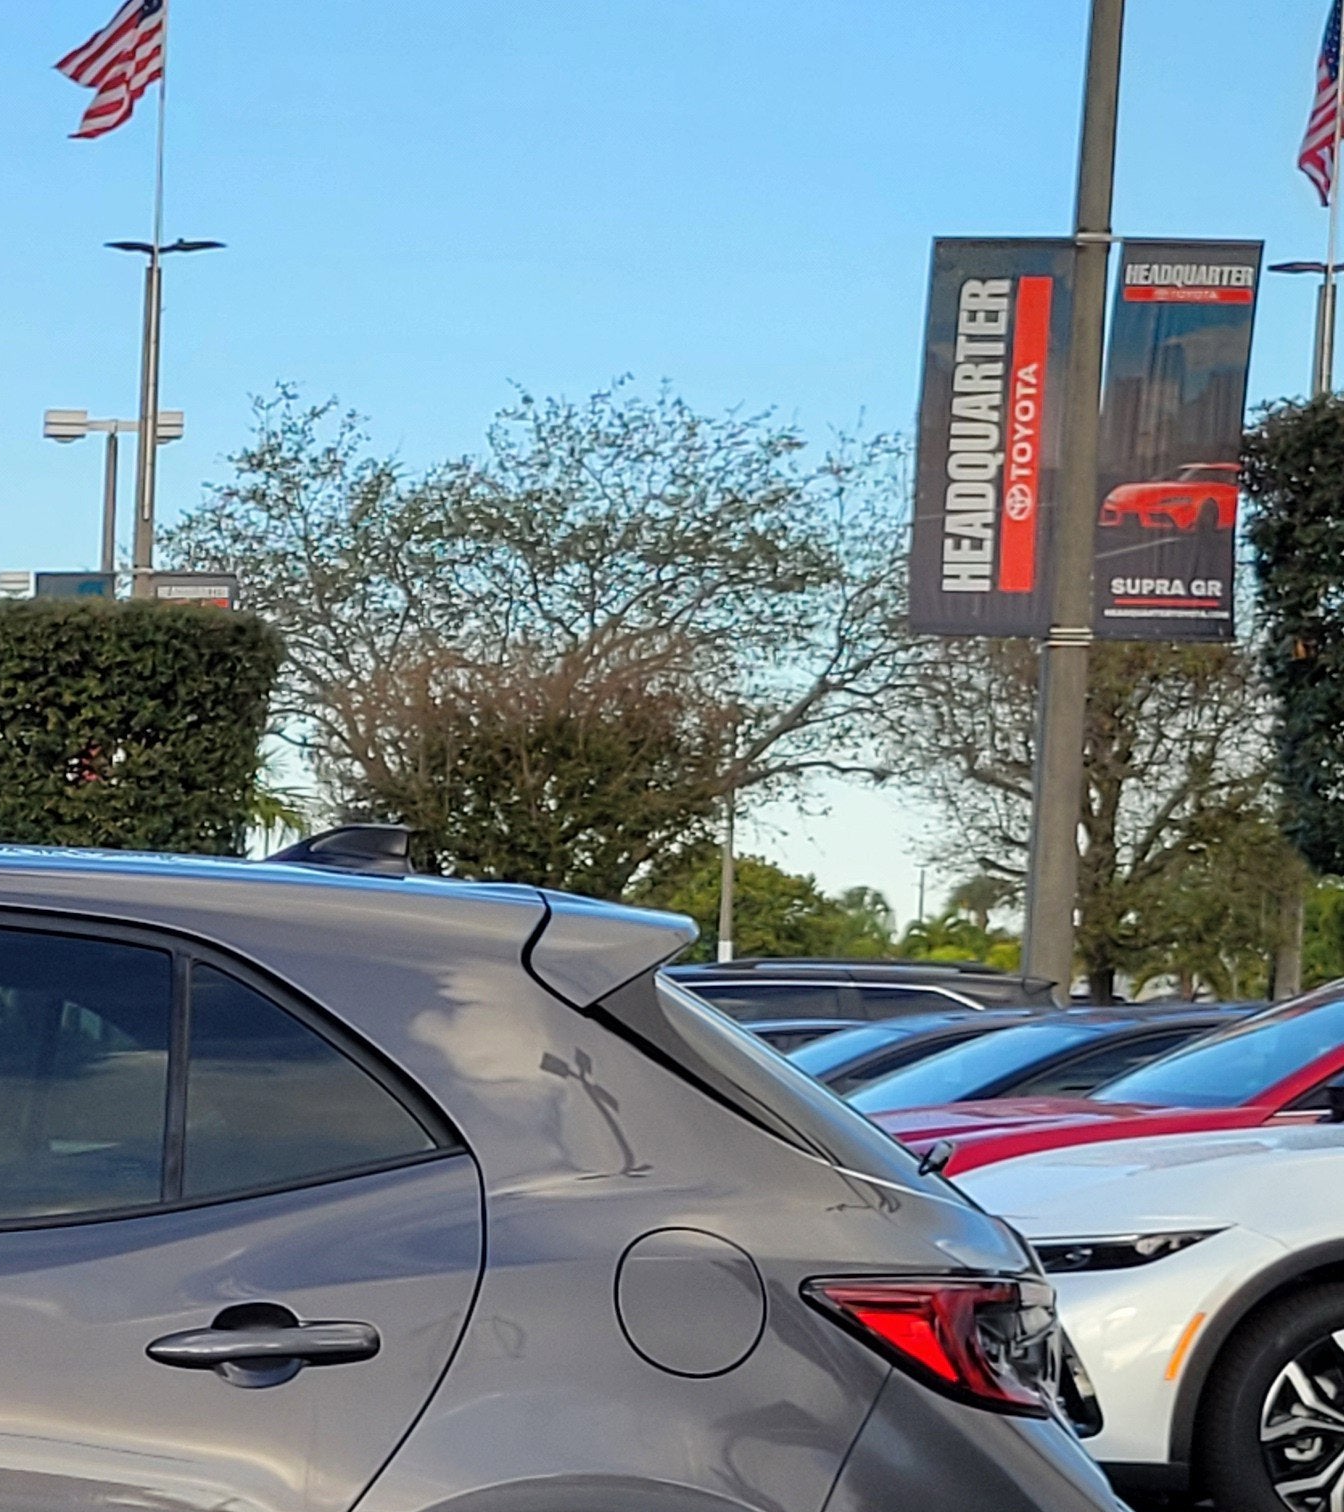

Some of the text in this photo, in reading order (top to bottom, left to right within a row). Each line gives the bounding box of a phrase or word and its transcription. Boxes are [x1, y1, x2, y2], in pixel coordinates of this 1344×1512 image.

[1125, 263, 1255, 287] HEADQUARTER
[942, 278, 1011, 592] HEADQUARTER
[1011, 362, 1039, 481] TOYOTA
[1111, 577, 1223, 597] SUPRA GR
